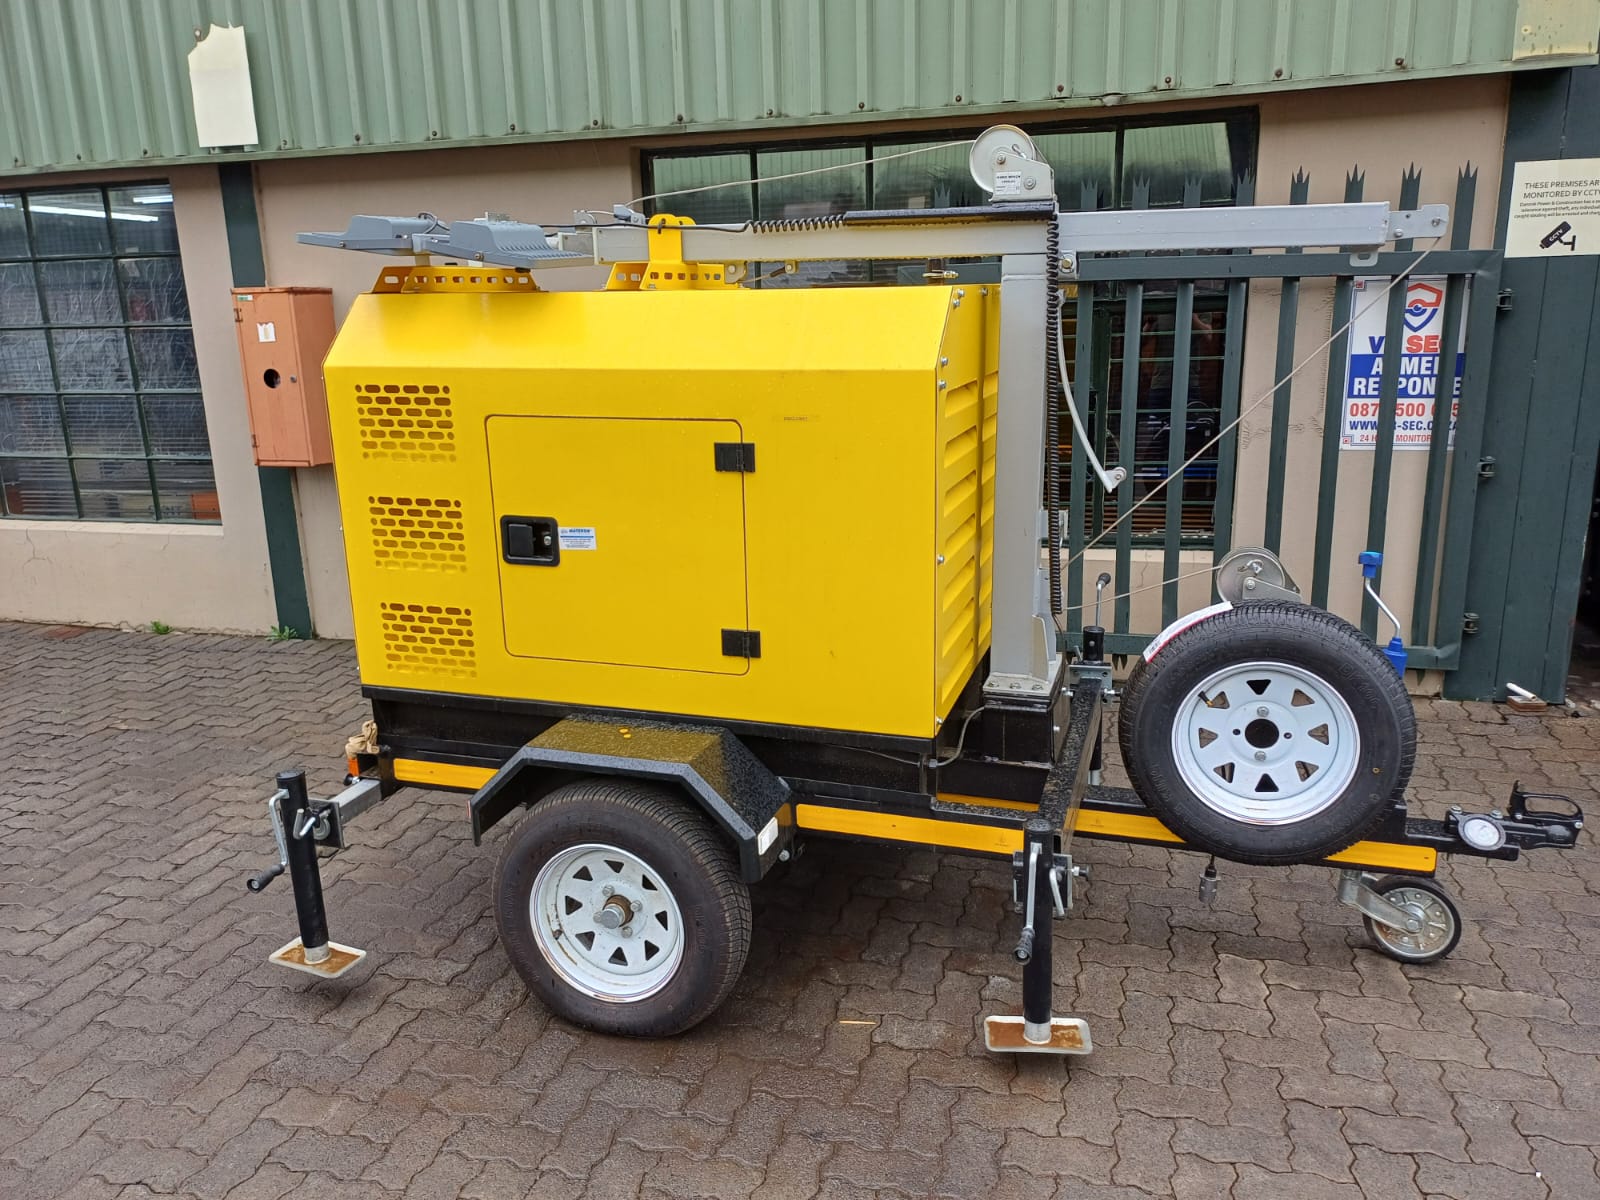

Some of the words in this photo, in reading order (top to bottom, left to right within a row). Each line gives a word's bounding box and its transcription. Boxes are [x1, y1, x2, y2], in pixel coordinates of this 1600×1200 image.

[1524, 191, 1570, 199] MONITORED
[1572, 189, 1583, 197] BY
[1549, 228, 1563, 242] CCTV
[1360, 434, 1369, 442] 24
